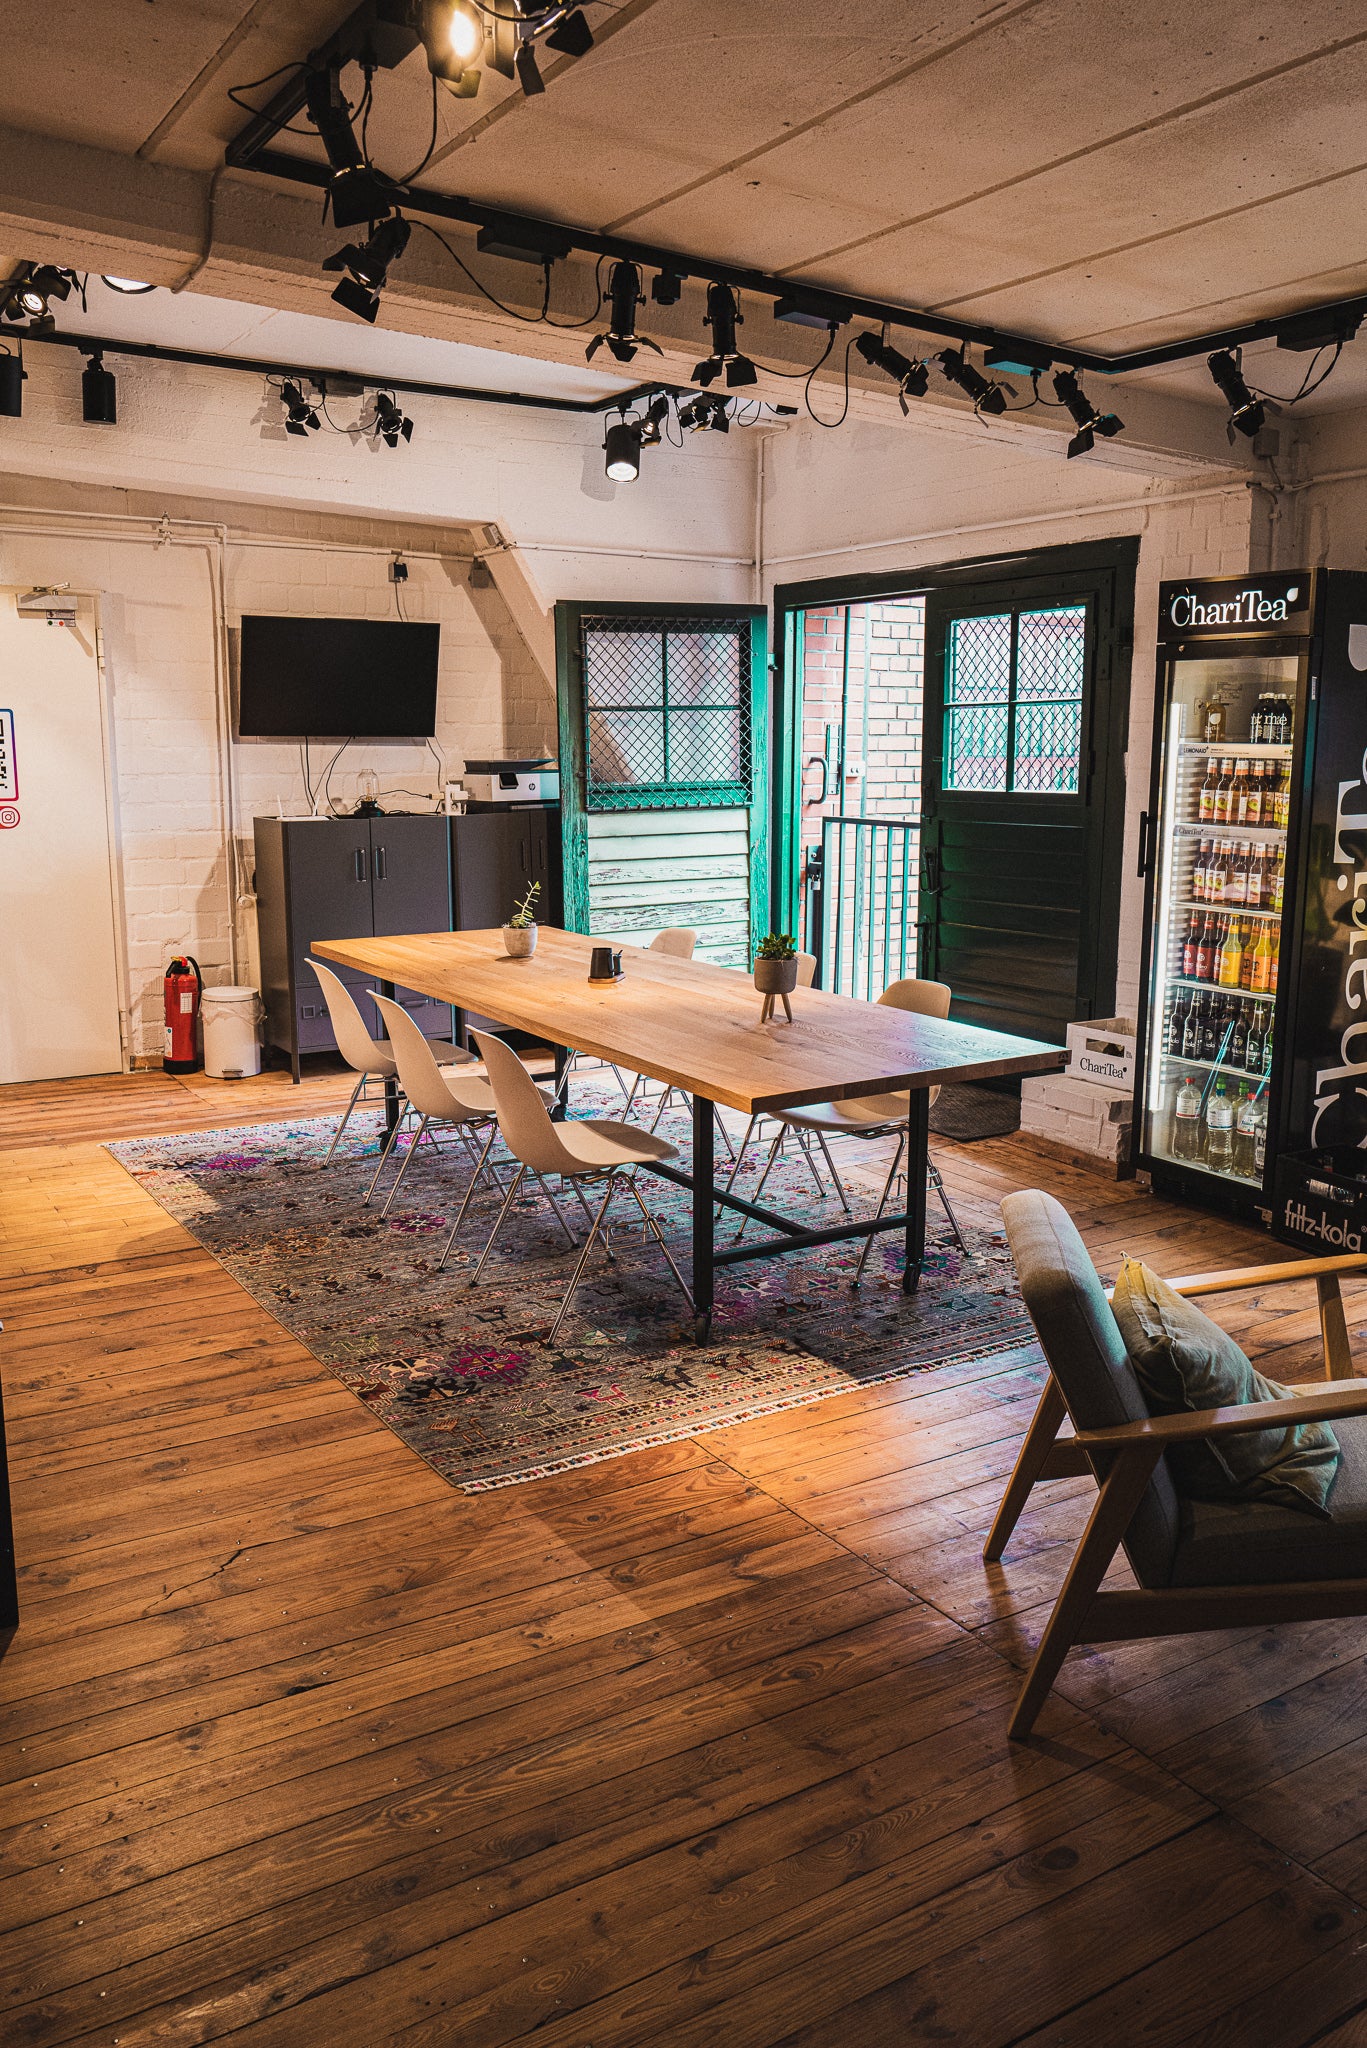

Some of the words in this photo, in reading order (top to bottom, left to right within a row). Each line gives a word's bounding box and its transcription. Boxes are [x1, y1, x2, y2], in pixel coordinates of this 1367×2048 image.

[1171, 590, 1289, 627] ChariTea
[1080, 1058, 1124, 1079] ChariTea
[1285, 1200, 1362, 1252] fritz-kola
